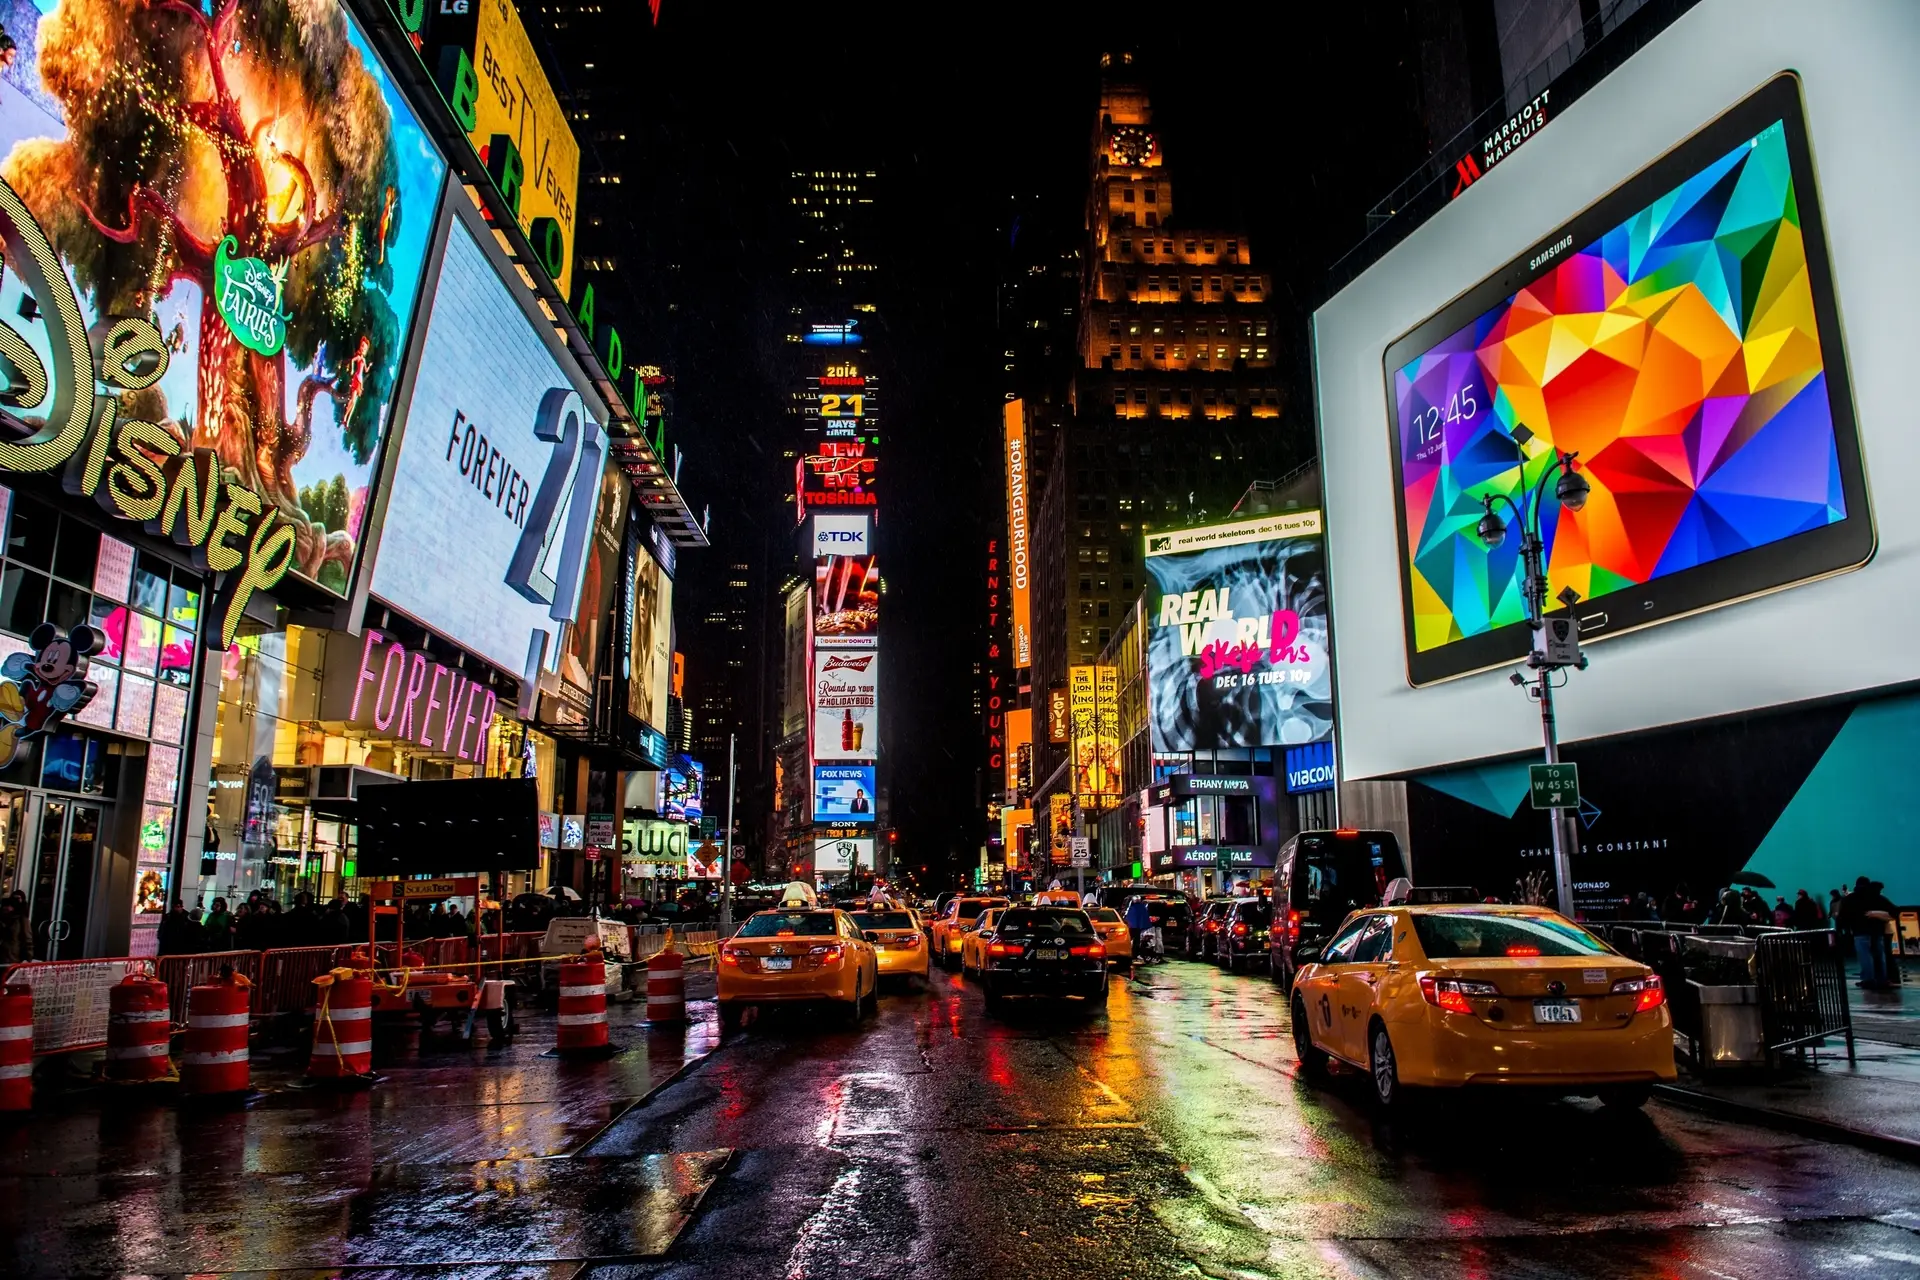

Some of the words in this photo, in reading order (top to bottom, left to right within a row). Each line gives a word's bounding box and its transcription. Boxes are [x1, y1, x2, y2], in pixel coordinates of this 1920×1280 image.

[1484, 89, 1550, 152] MARRIOTT
[483, 44, 517, 120] BEST
[516, 74, 550, 190] TV
[546, 167, 573, 233] EVER
[1485, 112, 1545, 168] MARQUIS
[1530, 234, 1573, 271] SAMSUNG
[220, 264, 278, 349] FAIRIES
[827, 366, 858, 378] 2014
[819, 377, 865, 386] TOSHIBA
[821, 394, 863, 416] 21
[1413, 384, 1477, 444] 12:45
[827, 419, 857, 429] DAYS
[820, 442, 865, 457] NEW
[446, 408, 531, 532] FOREVER
[823, 473, 860, 488] EVE
[805, 492, 877, 505] TOSHIBA
[1011, 438, 1027, 590] #ORANGEURHOOD
[829, 531, 863, 542] TDK
[1150, 536, 1172, 552] MTV
[1178, 536, 1193, 545] real
[1194, 532, 1216, 542] world
[1218, 528, 1255, 540] skeletons
[1258, 524, 1272, 533] dec
[1274, 523, 1283, 531] 16
[1284, 521, 1300, 530] tues
[1302, 519, 1316, 529] 10p
[988, 540, 997, 626] ERNST
[1159, 587, 1234, 627] REAL
[988, 644, 1000, 658] &
[825, 659, 869, 668] Budweise
[1216, 675, 1238, 689] DEC
[1242, 672, 1256, 687] 16
[1258, 670, 1286, 685] TUES
[1290, 669, 1311, 684] 10p
[818, 680, 847, 697] Round
[847, 685, 857, 694] up
[1073, 684, 1092, 693] LION
[349, 629, 497, 766] FOREVER
[818, 697, 874, 705] #HOLIDAYBUDS
[1072, 695, 1094, 705] KING
[989, 676, 1001, 768] YOUNG
[821, 770, 838, 778] FOX
[838, 770, 863, 778] NEWS
[1547, 768, 1560, 779] To
[1534, 781, 1546, 791] W
[1547, 780, 1562, 791] 45
[1563, 779, 1575, 791] St
[836, 841, 853, 850] NETS
[1597, 839, 1669, 853] CONSTANT
[1073, 849, 1088, 858] 25
[1184, 850, 1252, 861] AÉROPTALE
[1572, 881, 1610, 889] VORNADO
